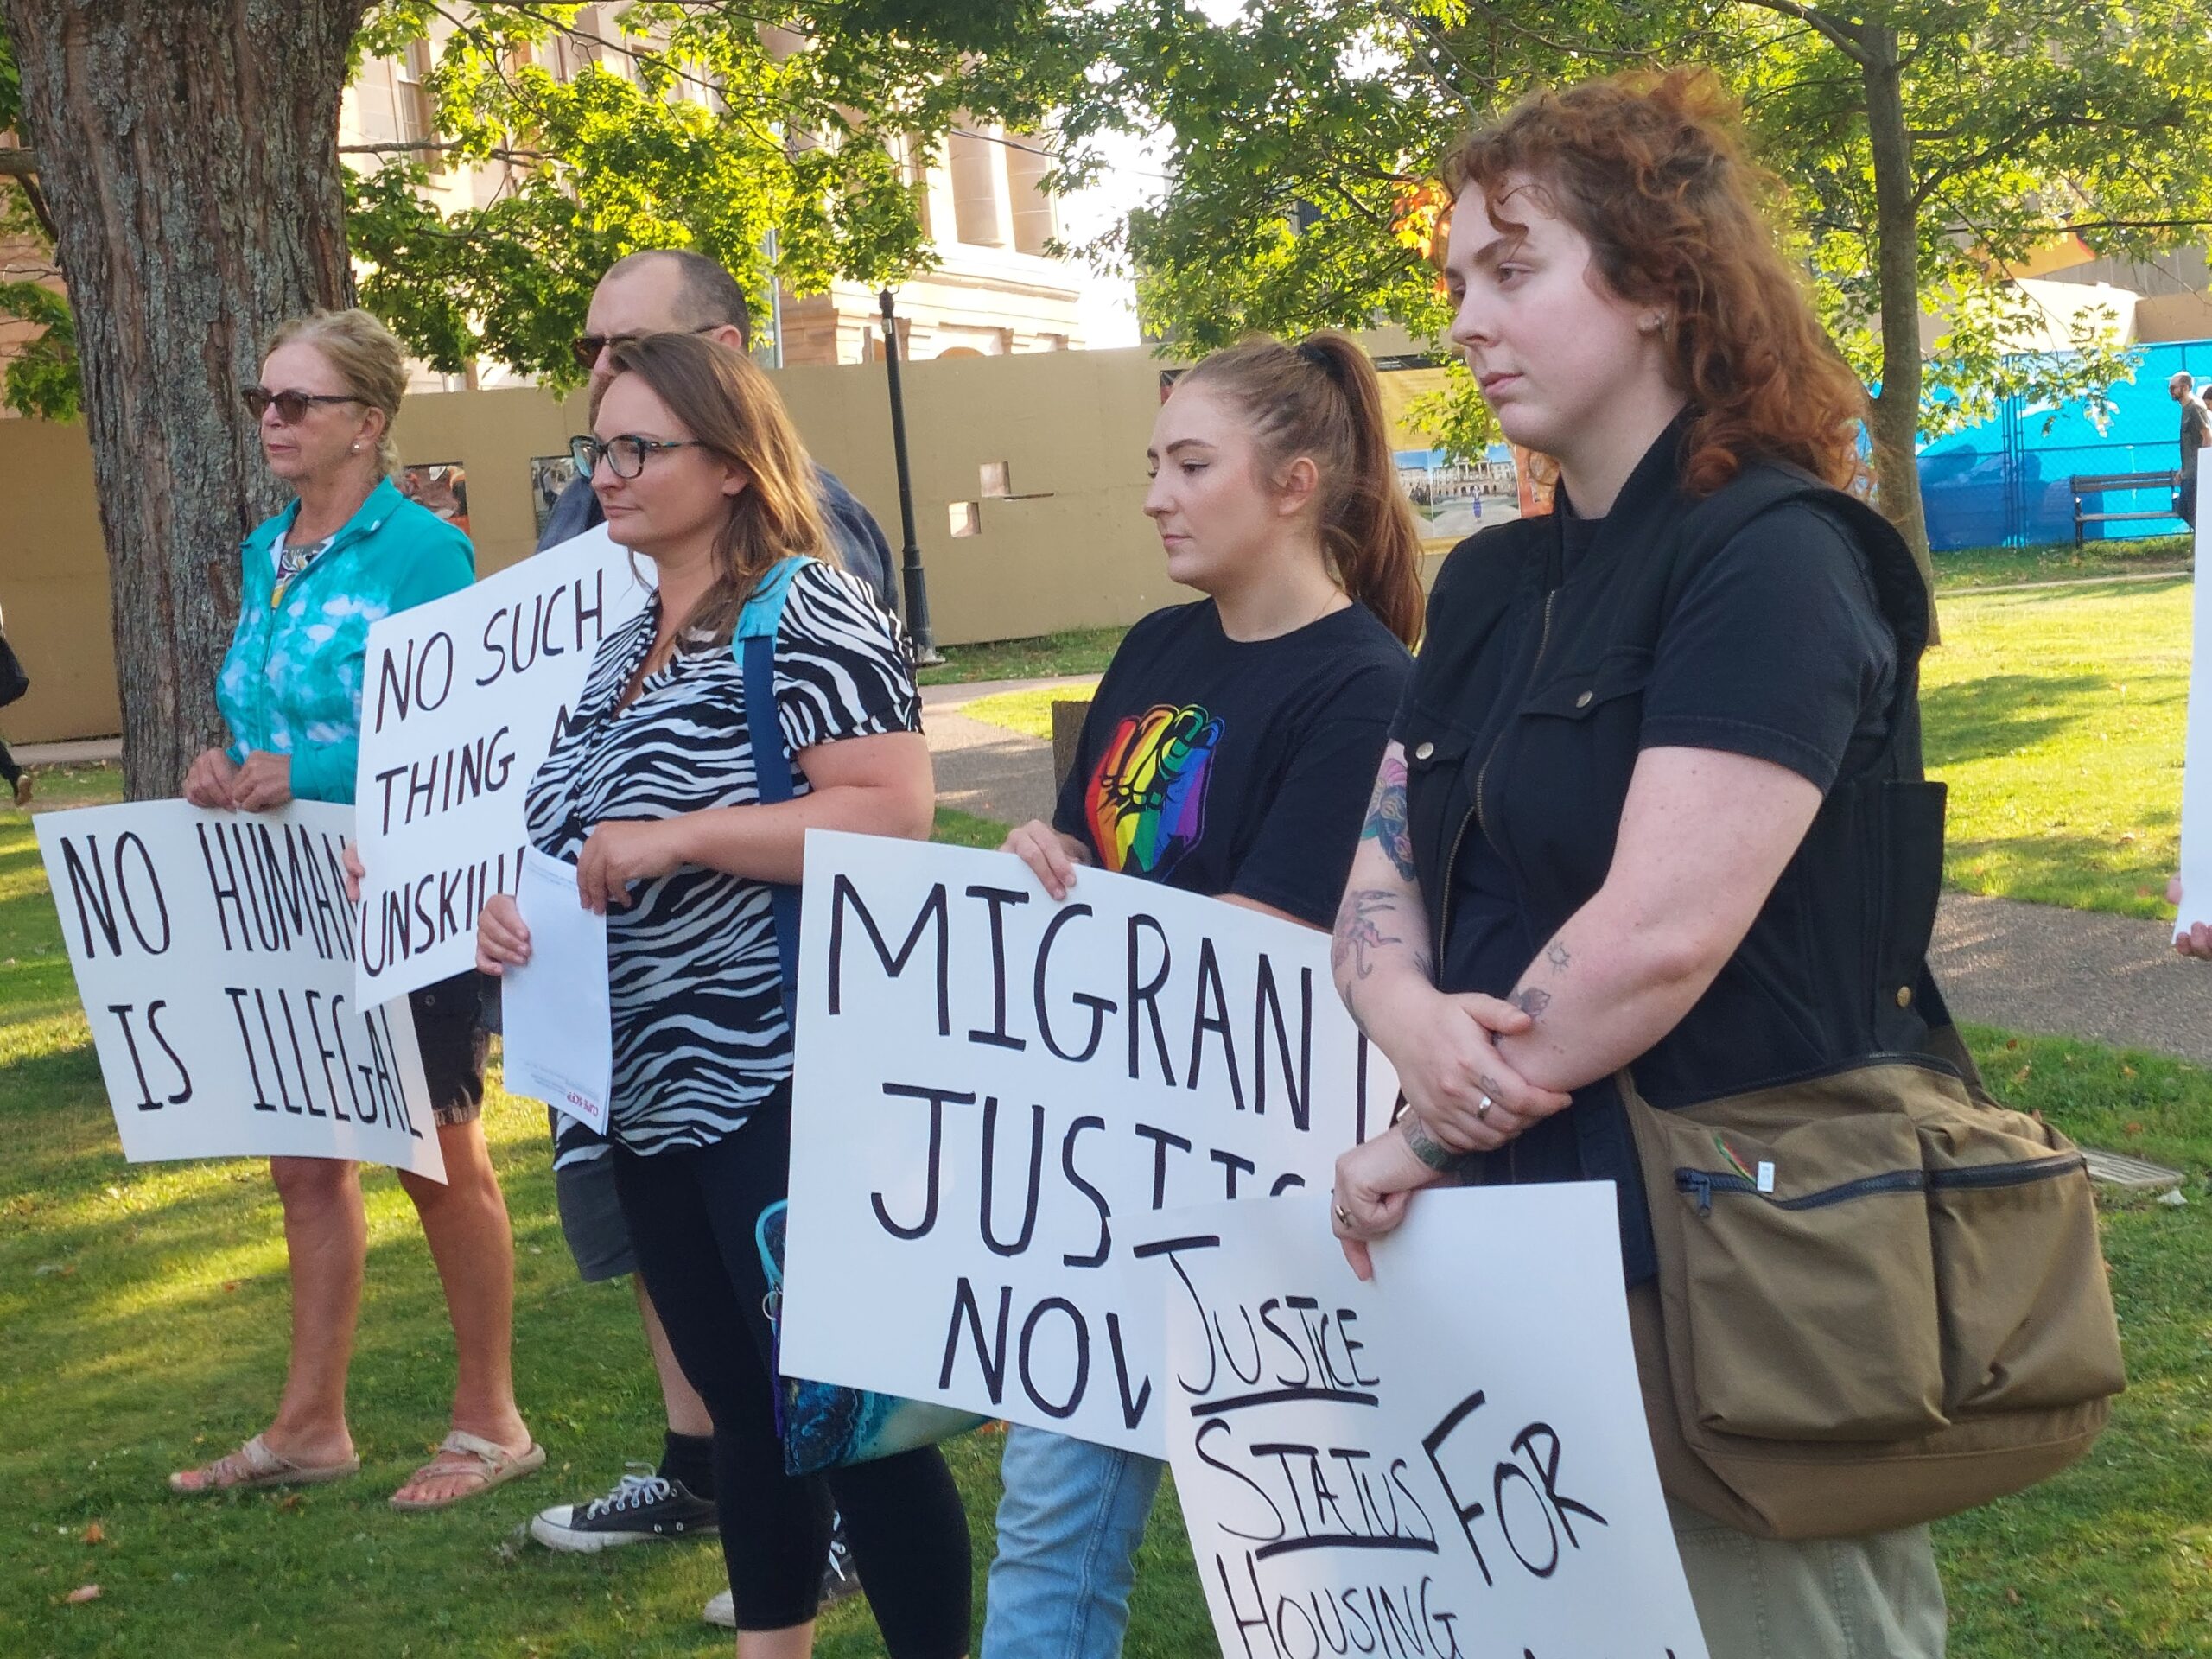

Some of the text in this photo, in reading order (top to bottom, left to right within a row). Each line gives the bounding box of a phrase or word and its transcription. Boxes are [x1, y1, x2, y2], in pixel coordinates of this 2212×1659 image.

[376, 567, 604, 734] NO SUCH
[375, 726, 516, 836] THING
[60, 831, 172, 959] NO
[108, 987, 424, 1139] IS ILLEGAL
[1133, 1235, 1380, 1394] JUSTICE
[1195, 1389, 1609, 1586] STATUS FOR
[1217, 1550, 1465, 1659] HOUSING
